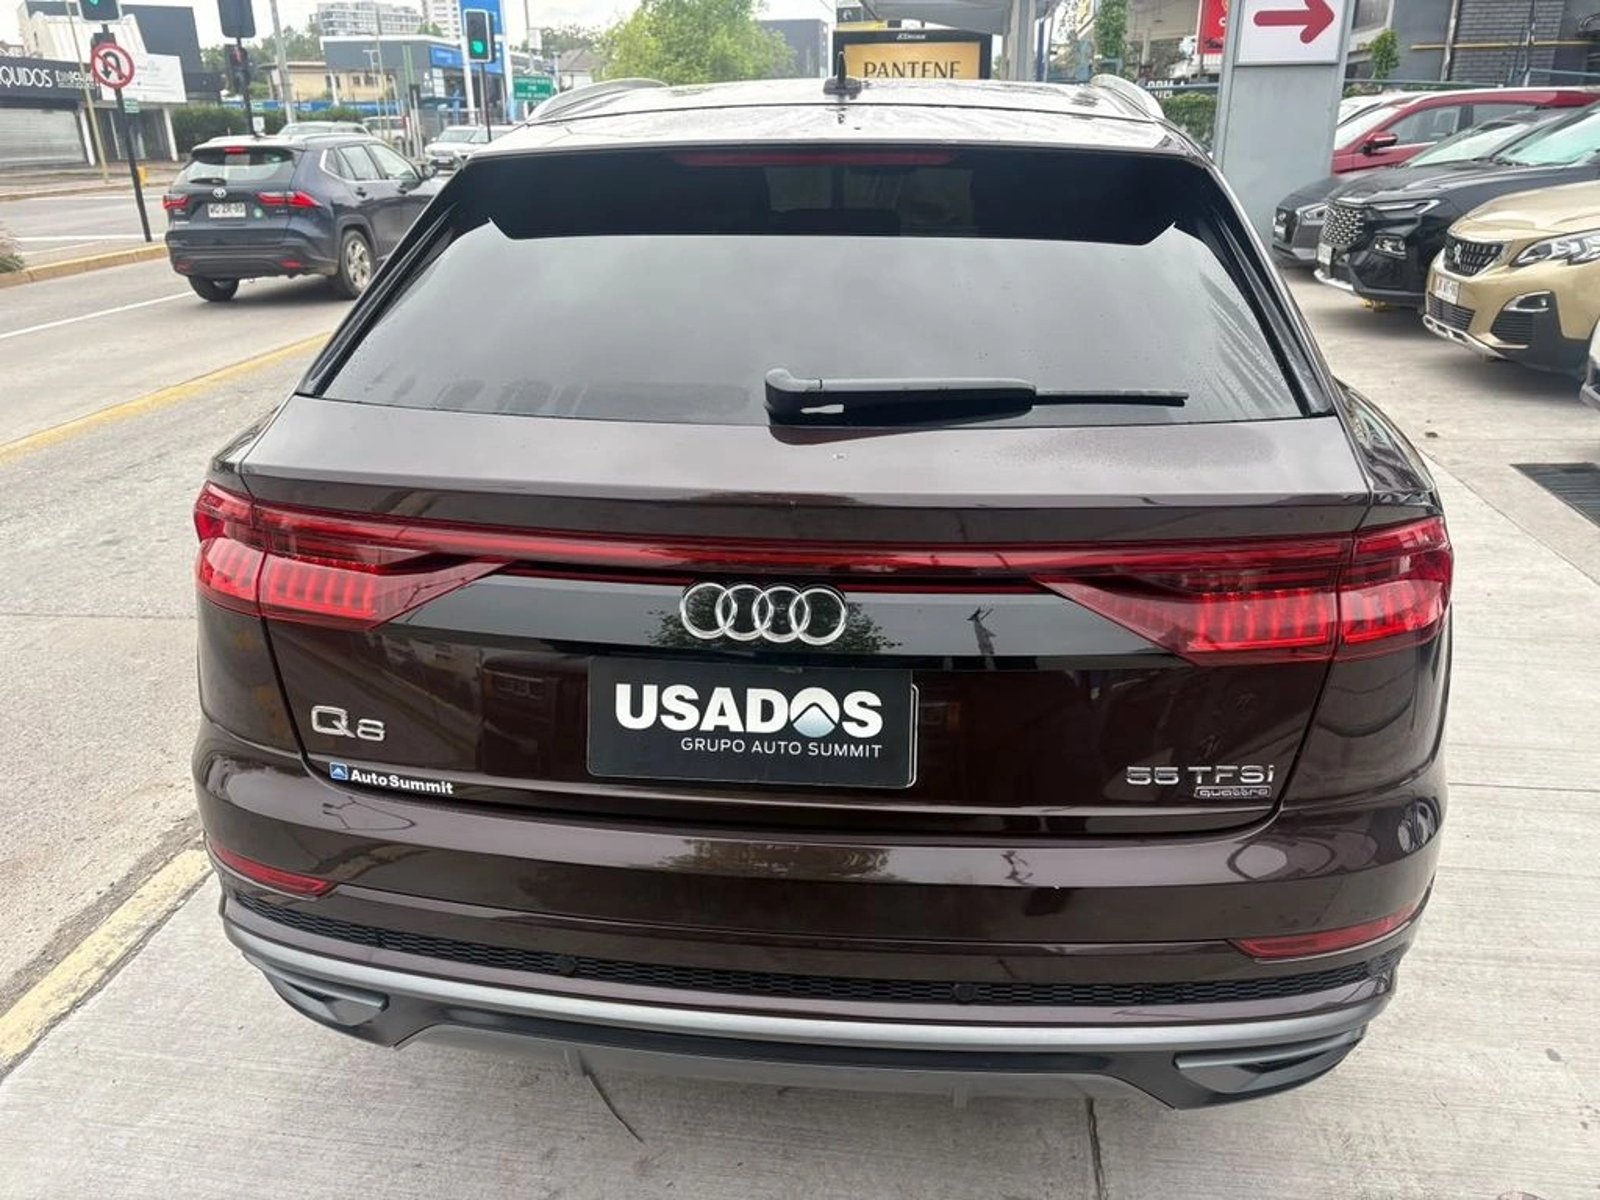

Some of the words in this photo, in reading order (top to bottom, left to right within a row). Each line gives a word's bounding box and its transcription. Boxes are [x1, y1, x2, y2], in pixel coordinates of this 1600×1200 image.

[863, 61, 961, 79] PANTENE
[615, 683, 883, 738] USADOS
[311, 705, 386, 742] Q8
[680, 737, 746, 753] GRUPO
[751, 740, 802, 755] AUTO
[807, 742, 882, 758] SUMMIT
[1126, 766, 1180, 786] 55
[1199, 787, 1268, 799] quattro
